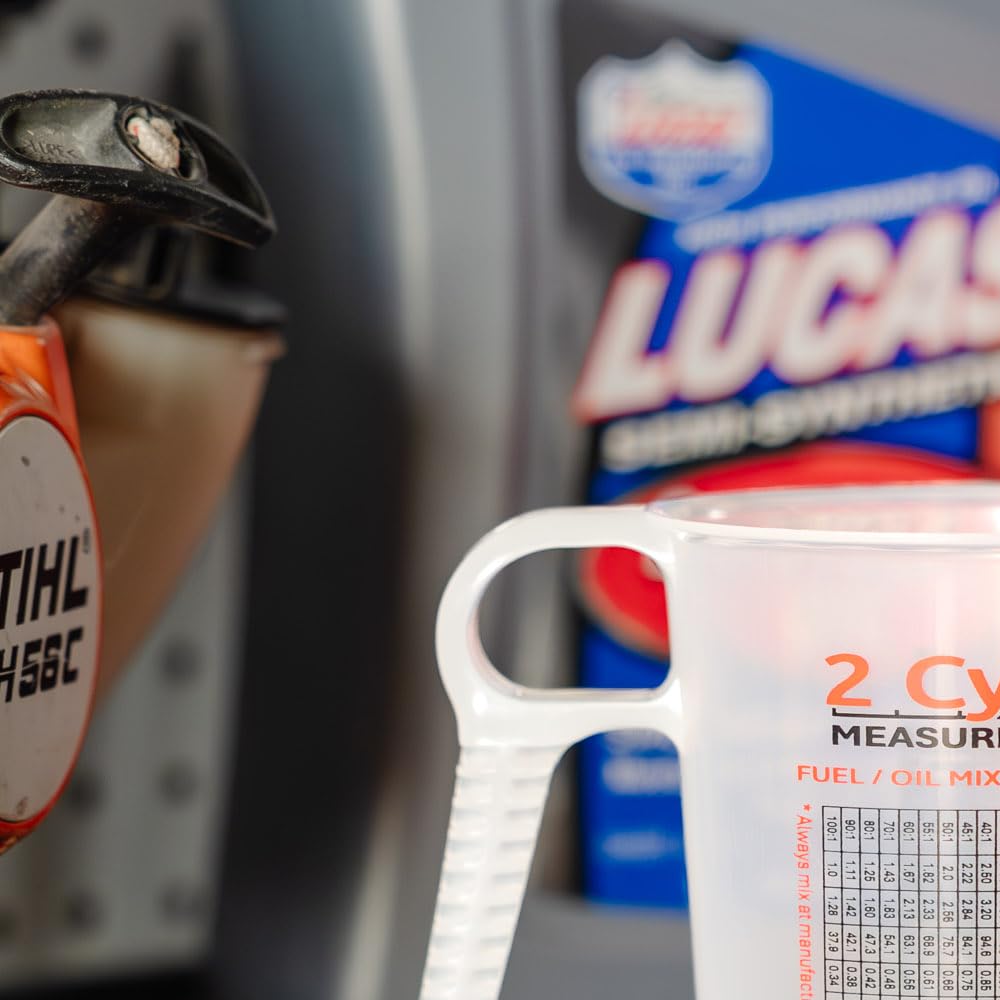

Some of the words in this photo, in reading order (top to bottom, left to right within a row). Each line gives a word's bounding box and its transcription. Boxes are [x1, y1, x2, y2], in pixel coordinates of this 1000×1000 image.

[825, 653, 871, 706] 2
[797, 765, 864, 784] FUEL
[872, 769, 881, 784] /
[891, 769, 940, 786] OIL
[826, 816, 838, 841] 100:1
[845, 820, 856, 839] 90:1
[883, 821, 895, 840] 70:1
[962, 822, 974, 842] 45:1
[981, 822, 992, 842] 40:1
[794, 815, 812, 868] Always
[827, 863, 838, 877] 1.0
[883, 862, 895, 882] 1.43
[962, 863, 974, 884] 2.22
[799, 875, 812, 899] mix
[799, 905, 811, 919] at
[846, 897, 857, 917] 1.42
[903, 898, 915, 920] 2.13
[846, 932, 857, 952] 42.1
[864, 933, 876, 954] 47.3
[829, 965, 839, 986] 0.34
[865, 968, 876, 988] 0.42
